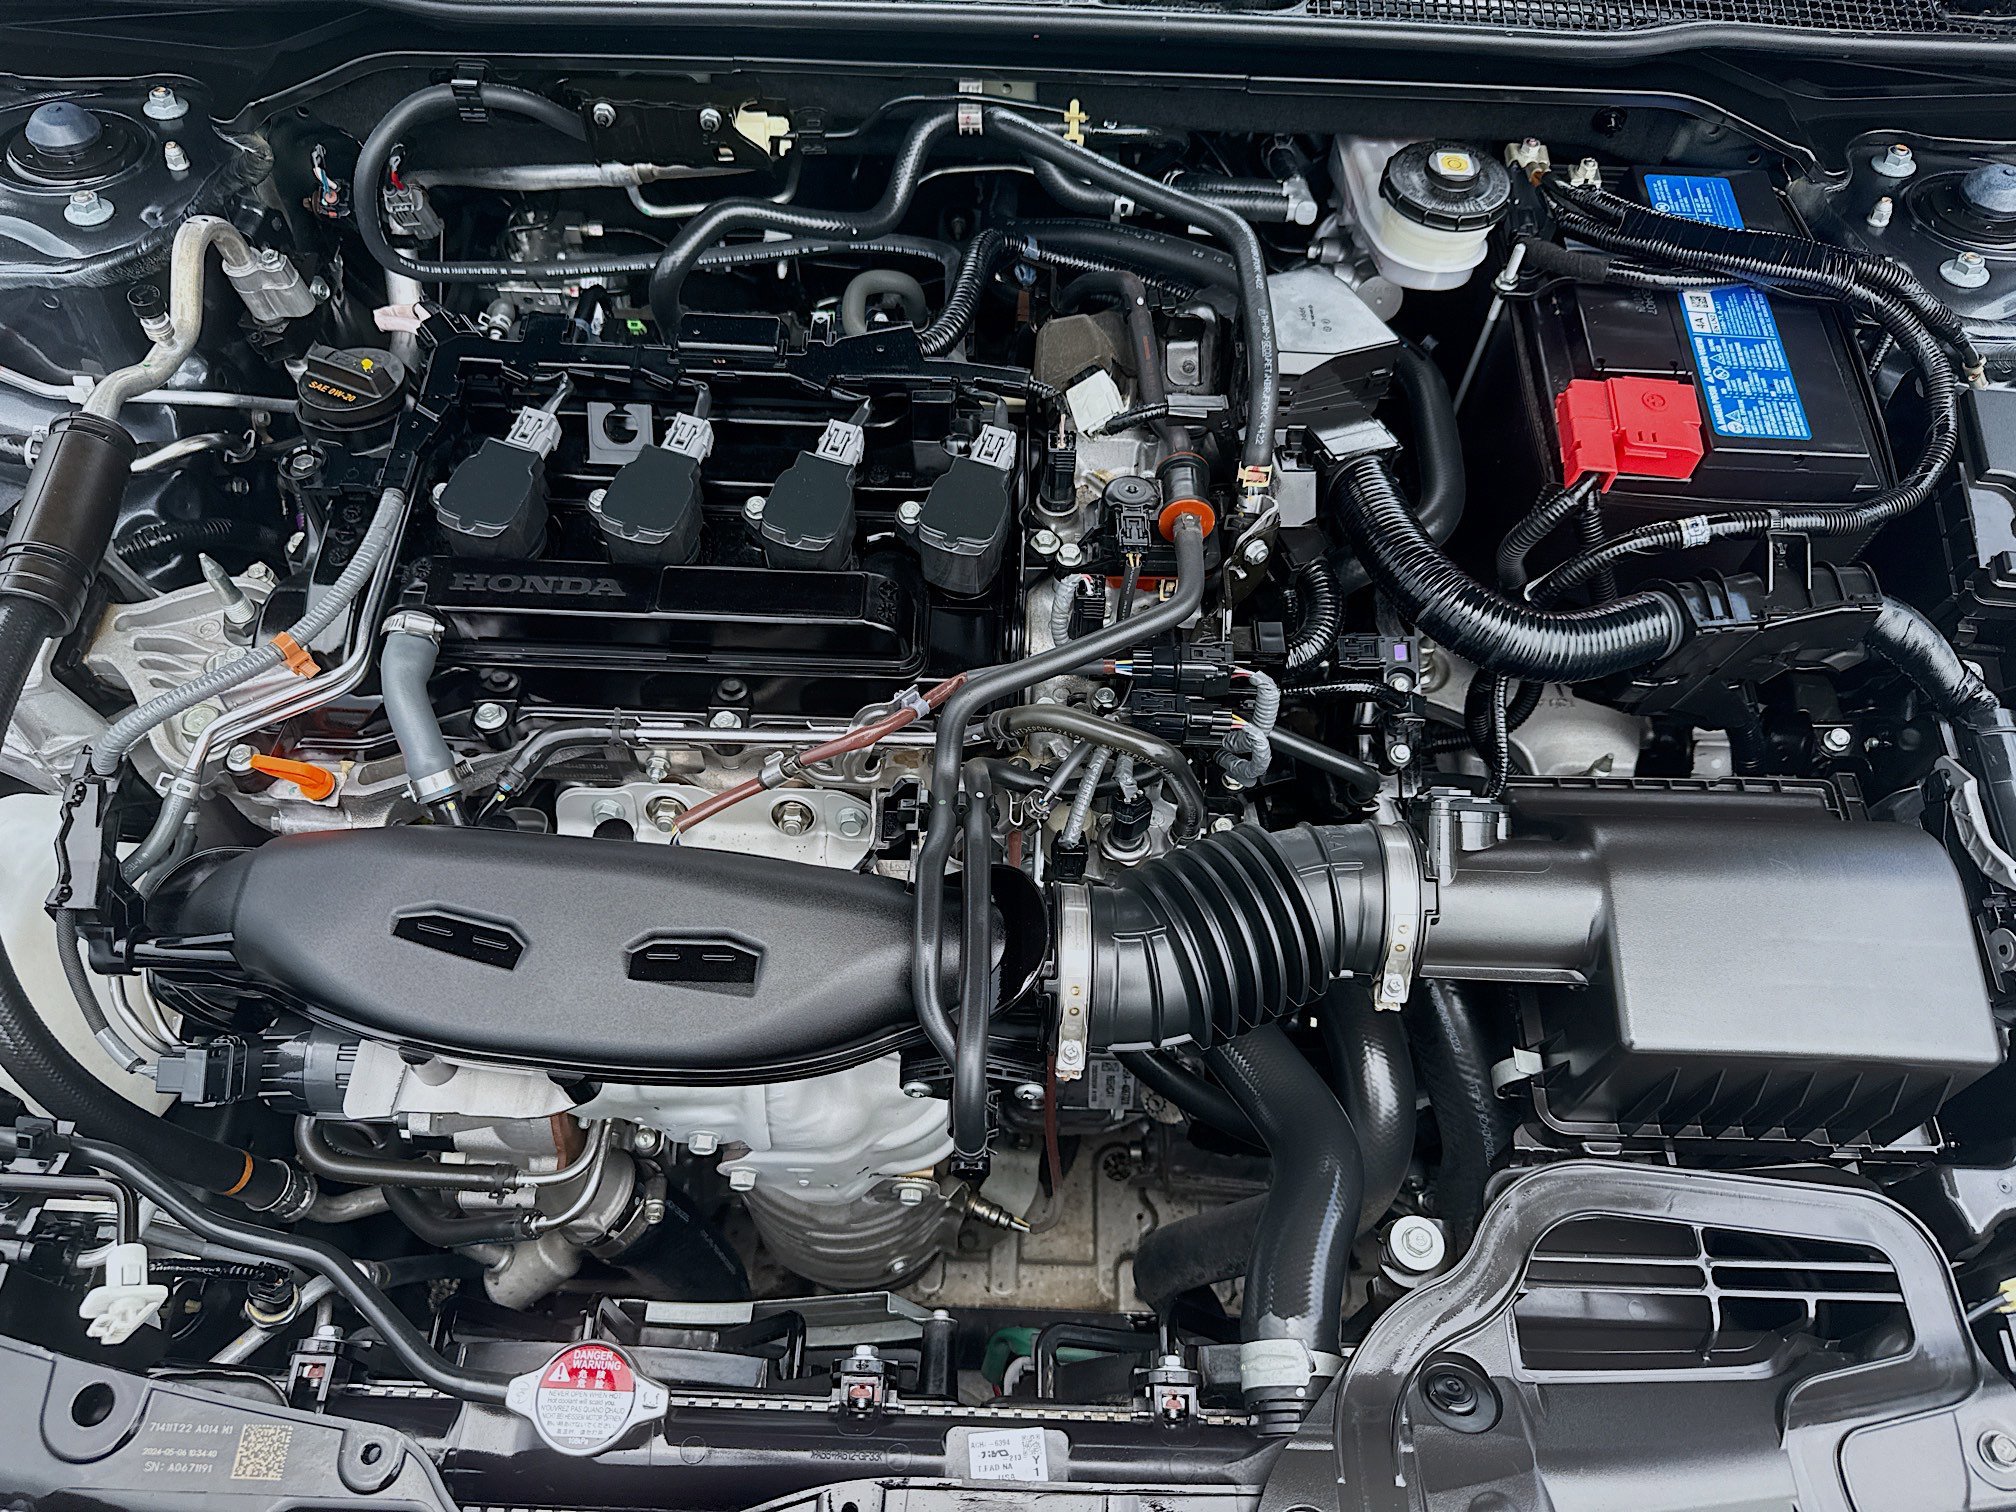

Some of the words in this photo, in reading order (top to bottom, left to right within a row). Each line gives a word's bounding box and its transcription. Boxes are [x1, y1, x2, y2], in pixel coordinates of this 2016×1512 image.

[308, 381, 330, 393] SAE
[328, 387, 357, 402] 0W-20
[449, 573, 627, 597] HONDA
[573, 1350, 614, 1360] DANGER
[572, 1360, 621, 1370] WARNUNG
[196, 1424, 219, 1434] A014
[222, 1425, 234, 1435] M1
[142, 1447, 187, 1457] 2024-05-06
[1032, 1455, 1040, 1464] Y
[143, 1461, 165, 1473] SN:
[1033, 1467, 1040, 1477] 1
